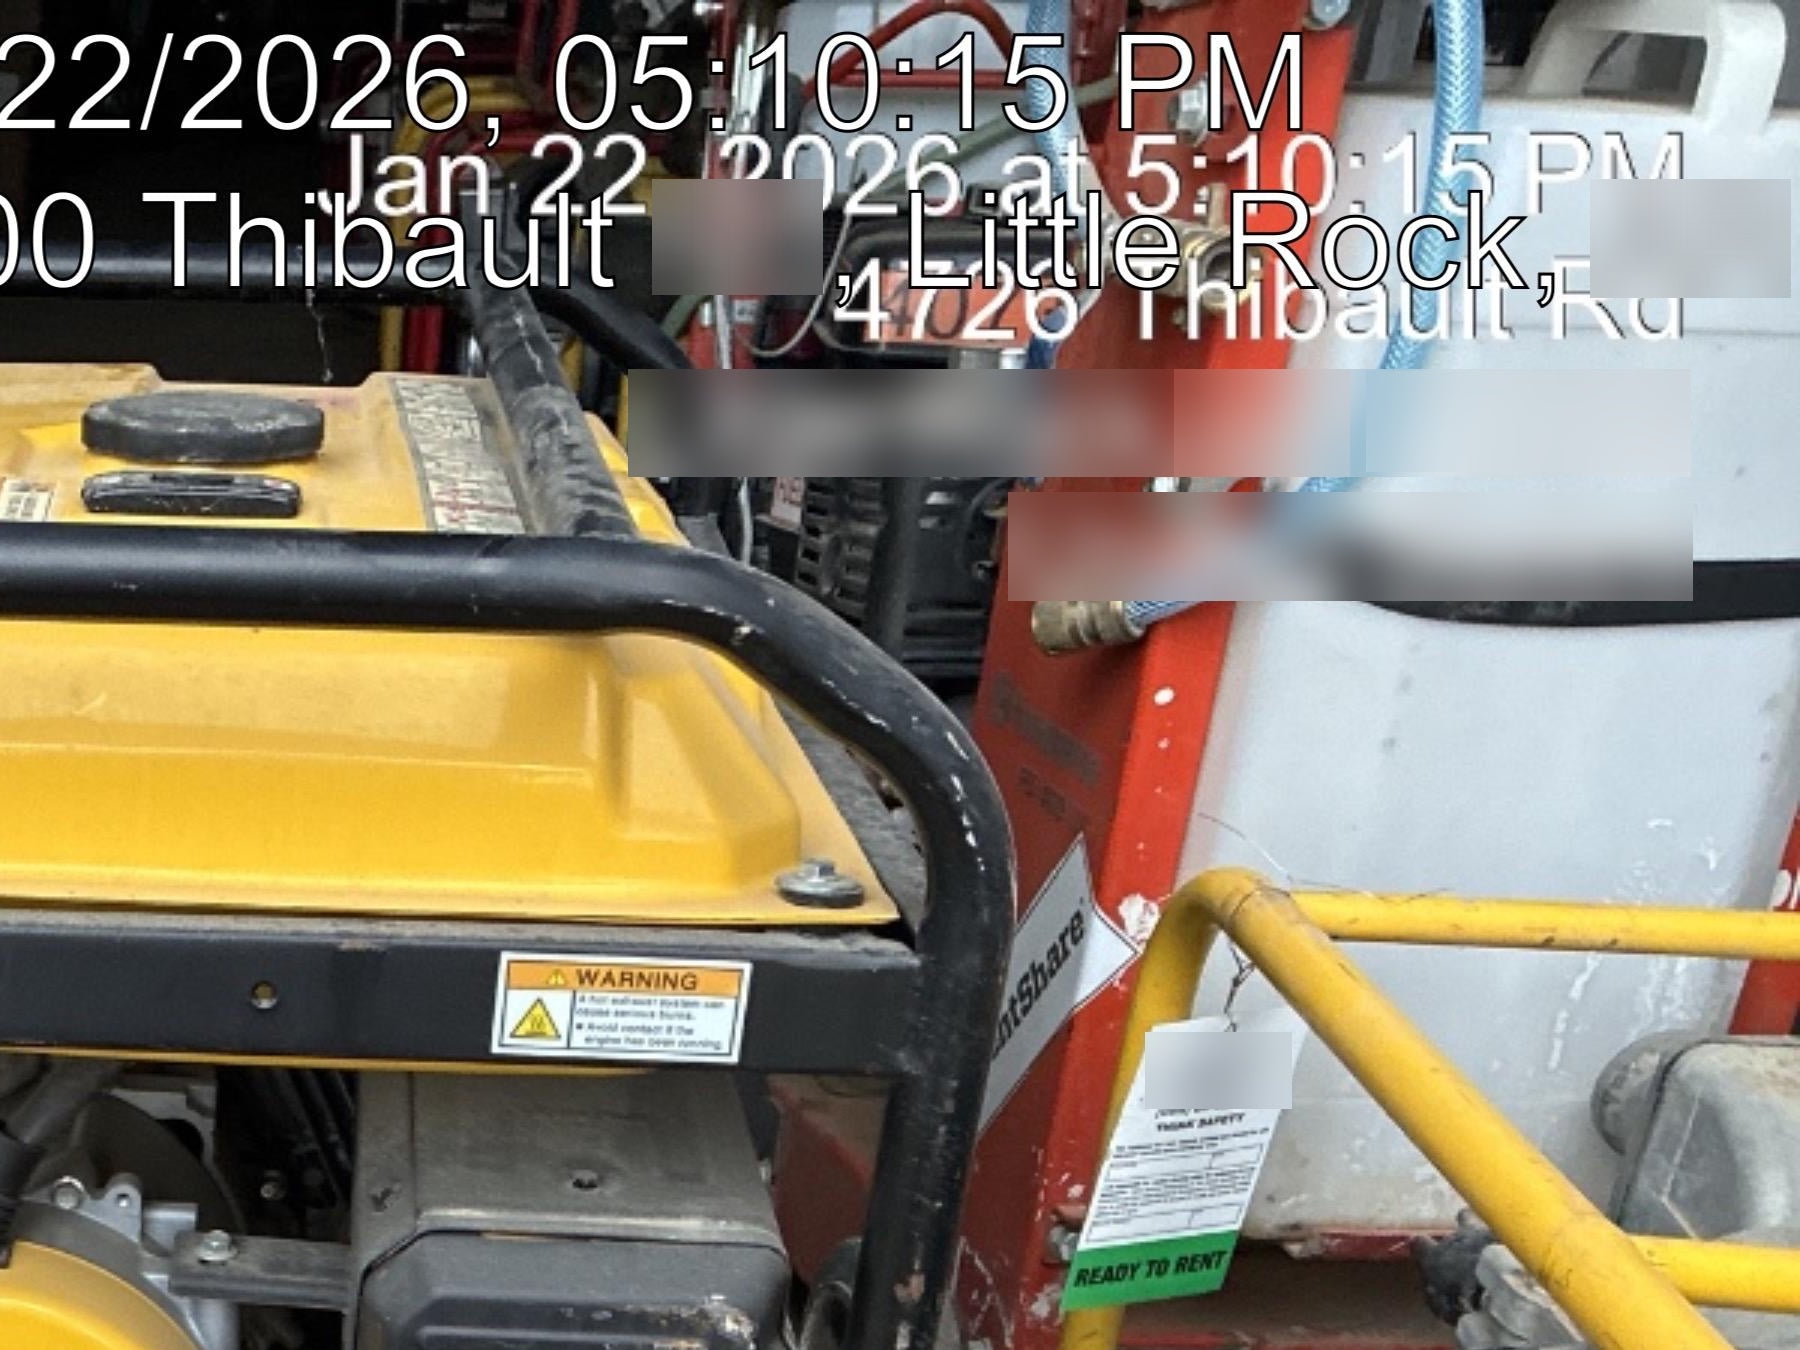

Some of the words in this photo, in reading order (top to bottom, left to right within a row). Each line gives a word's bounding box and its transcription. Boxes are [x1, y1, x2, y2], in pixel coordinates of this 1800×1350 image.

[576, 968, 699, 991] WARNING
[1074, 1261, 1141, 1288] READY
[1144, 1258, 1170, 1280] TO
[1172, 1250, 1228, 1275] RENT
